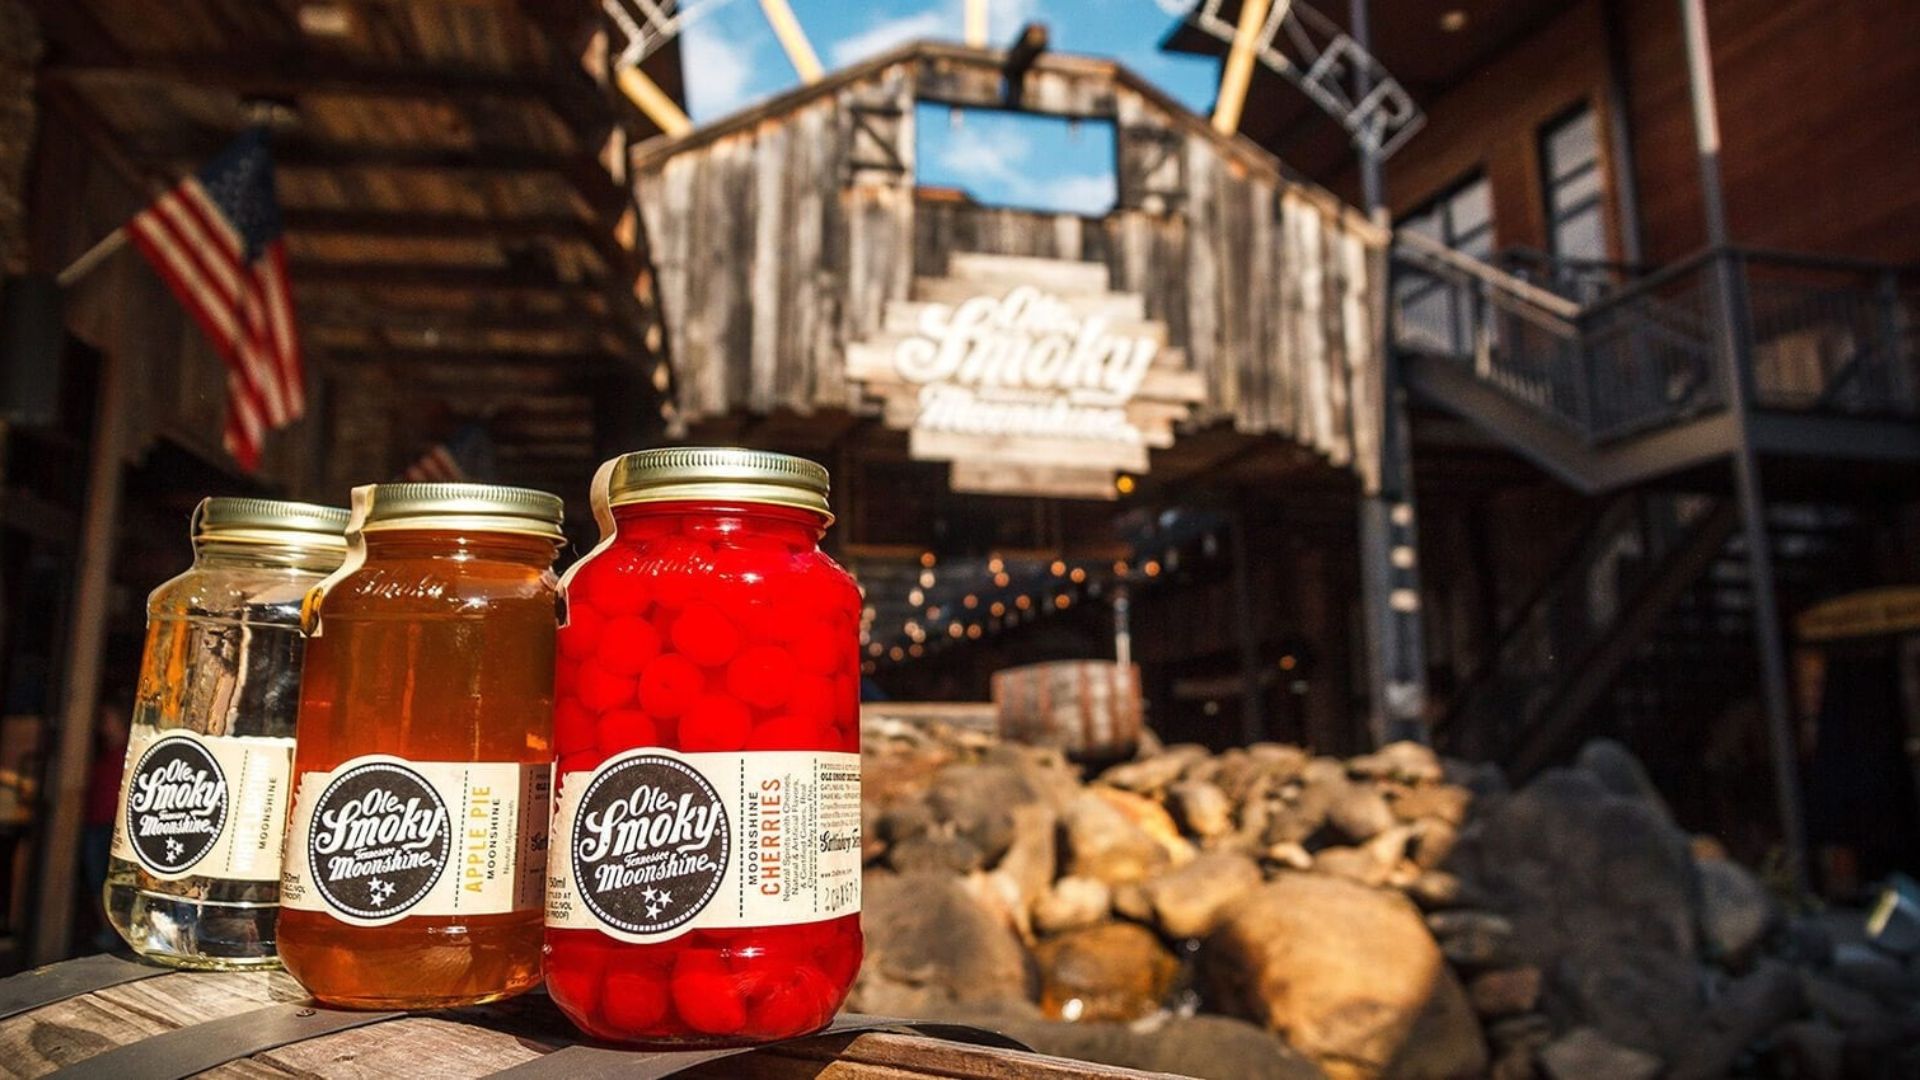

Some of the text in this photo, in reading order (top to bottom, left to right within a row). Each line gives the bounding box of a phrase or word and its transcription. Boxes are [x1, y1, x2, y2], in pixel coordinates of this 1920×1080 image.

[895, 296, 1156, 405] Smoky
[167, 758, 196, 783] Ole
[131, 767, 226, 816] Smoky
[362, 788, 404, 817] Ole
[630, 784, 678, 817] Ole
[139, 813, 215, 837] Moonshine
[258, 776, 278, 850] MOONSHINE
[315, 797, 446, 855] Smoky
[579, 791, 722, 863] Smoky
[782, 815, 791, 834] with
[464, 785, 491, 893] APPLE PIE
[487, 798, 500, 880] MOONSHINE
[748, 791, 759, 886] MOONSHINE
[760, 778, 781, 896] CHERRIES
[783, 837, 792, 866] Spirits
[327, 850, 437, 882] Moonshine
[595, 852, 718, 893] Moonshine
[624, 850, 671, 867] Tennessee
[783, 869, 791, 902] Neutral
[791, 862, 800, 896] Natural
